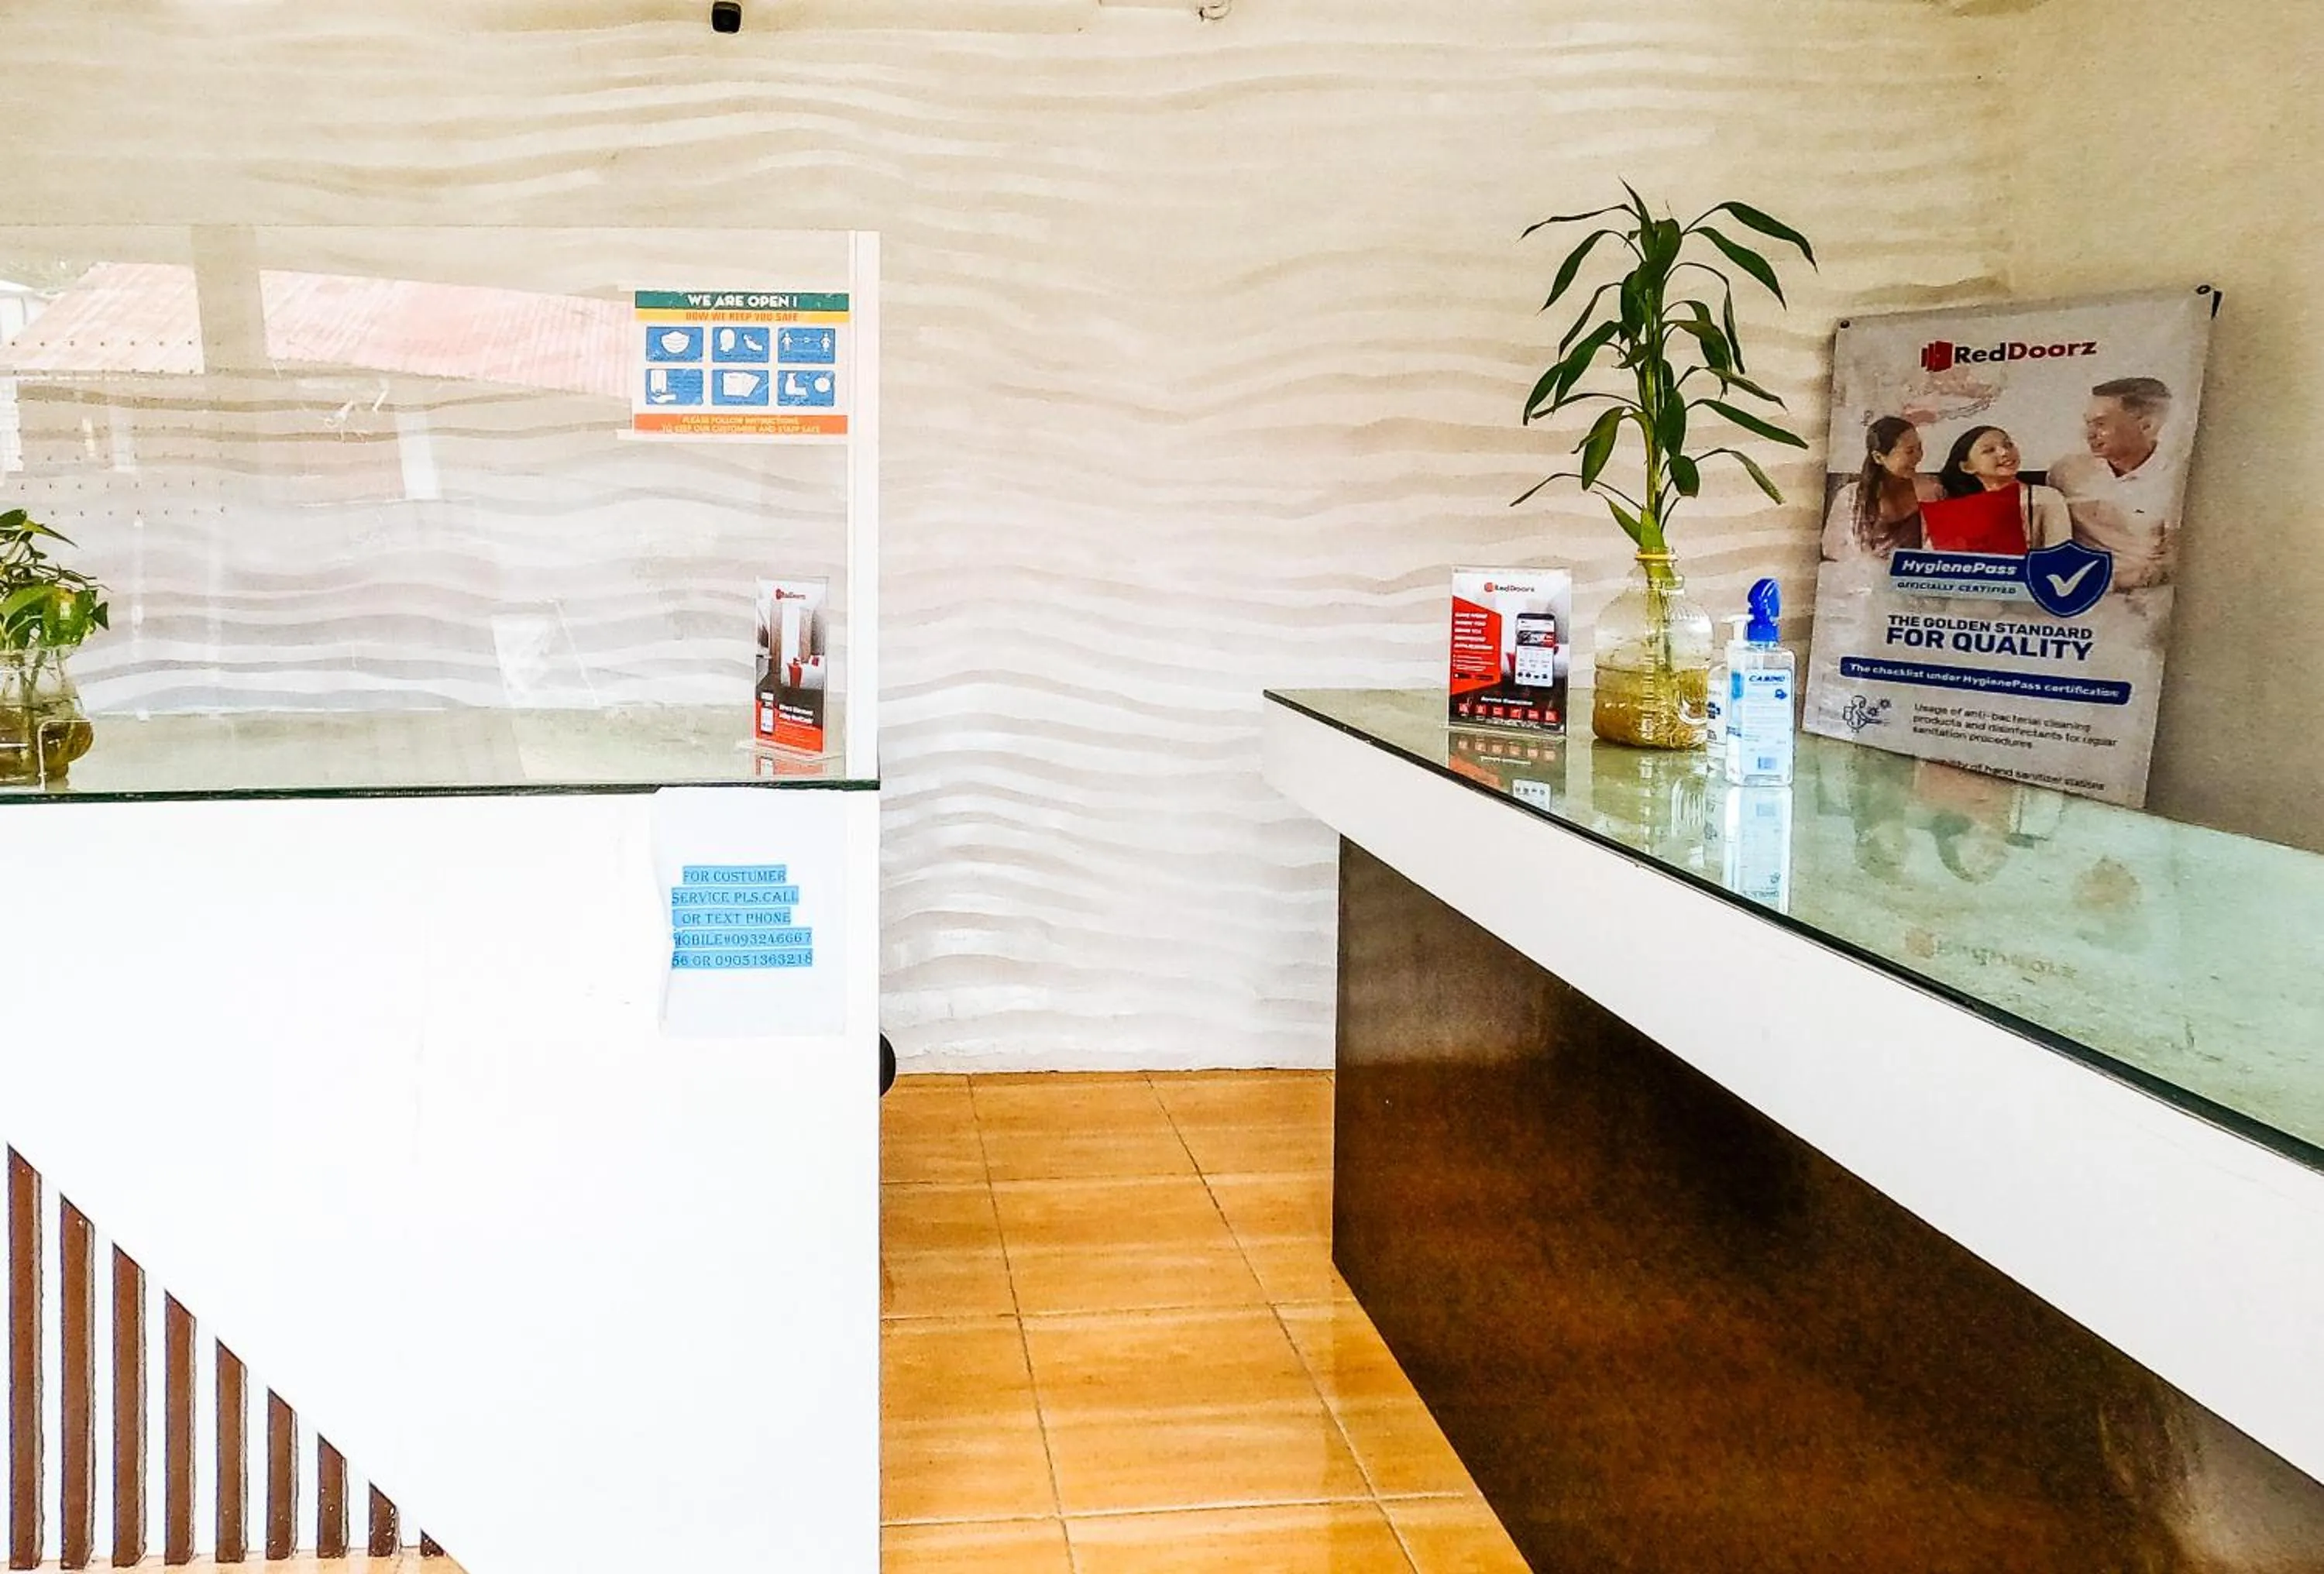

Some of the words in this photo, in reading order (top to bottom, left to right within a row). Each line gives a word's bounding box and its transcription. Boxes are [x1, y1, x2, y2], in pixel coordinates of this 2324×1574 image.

[687, 294, 711, 307] WE
[714, 294, 744, 308] ARE
[748, 295, 789, 308] OPEN
[710, 312, 725, 321] WE
[729, 312, 751, 321] KEEP
[775, 313, 798, 322] SAFE
[1954, 340, 2098, 364] RedDoorz
[1901, 559, 2017, 576] HygienePass
[1897, 582, 1954, 591] OFFICIALLY
[1958, 585, 2017, 594] CERTIFIED
[1887, 614, 1920, 627] THE
[1923, 617, 1990, 633] GOLDEN
[1995, 622, 2094, 640] STANDARD
[1886, 627, 1945, 649] FOR
[1951, 631, 2095, 662] QUALITY
[1849, 662, 1872, 674] The
[1872, 666, 1924, 679] checklist
[1927, 672, 1961, 682] under
[1962, 675, 2042, 691] HygienePass
[2044, 683, 2120, 697] certification
[1914, 703, 1948, 714] Usage
[1950, 706, 1962, 715] of
[1913, 716, 1962, 727] products
[1965, 721, 1986, 730] and
[683, 869, 709, 882] FOR
[713, 869, 787, 884] COSTUMER
[672, 891, 729, 905] SERVICE
[682, 912, 701, 925] OR
[705, 912, 742, 924] TEXT
[746, 911, 791, 924] PHONE
[692, 954, 711, 967] OR
